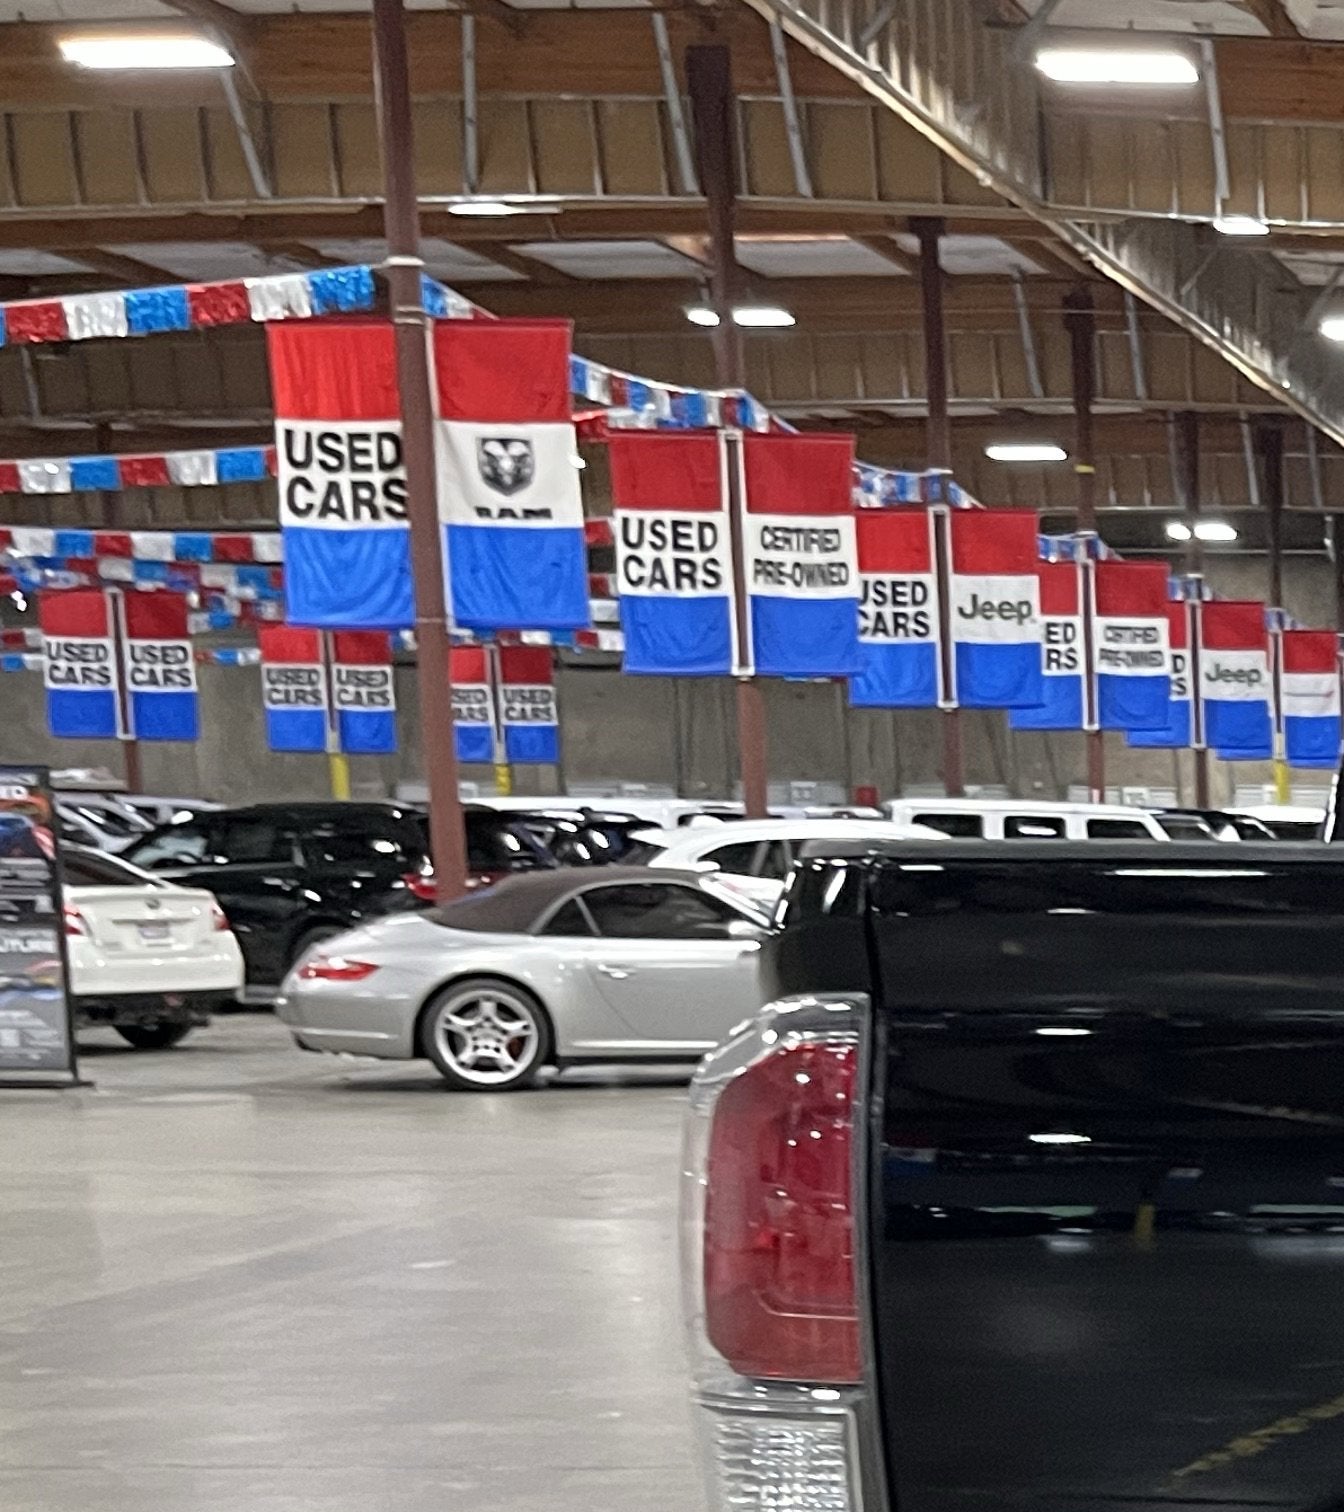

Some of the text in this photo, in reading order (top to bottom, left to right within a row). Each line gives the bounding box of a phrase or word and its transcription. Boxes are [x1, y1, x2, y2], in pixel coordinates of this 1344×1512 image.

[285, 429, 402, 472] USED
[287, 475, 408, 520] CARS
[622, 517, 717, 552] USED
[623, 555, 722, 590] CARS
[957, 594, 1032, 626] Jeep
[46, 641, 108, 662] USED
[130, 643, 189, 664] USED
[49, 664, 111, 685] CARS
[131, 666, 192, 687] CARS
[1204, 663, 1262, 687] Jeep
